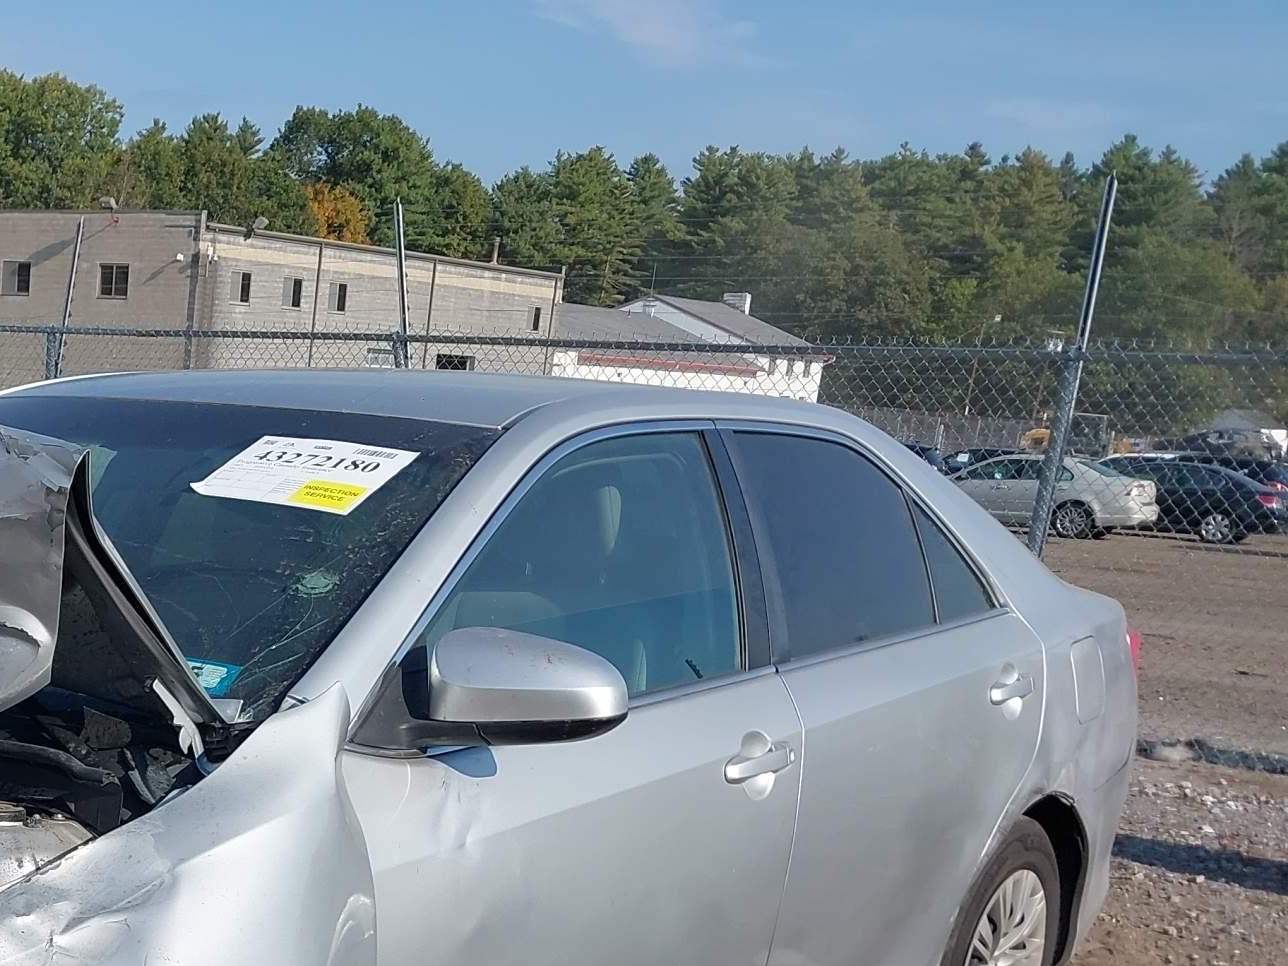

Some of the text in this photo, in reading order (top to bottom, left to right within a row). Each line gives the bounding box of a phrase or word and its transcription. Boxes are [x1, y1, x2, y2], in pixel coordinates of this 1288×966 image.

[253, 450, 381, 473] 43272180
[303, 484, 360, 498] INSPECTION
[303, 491, 345, 503] SERVICE
